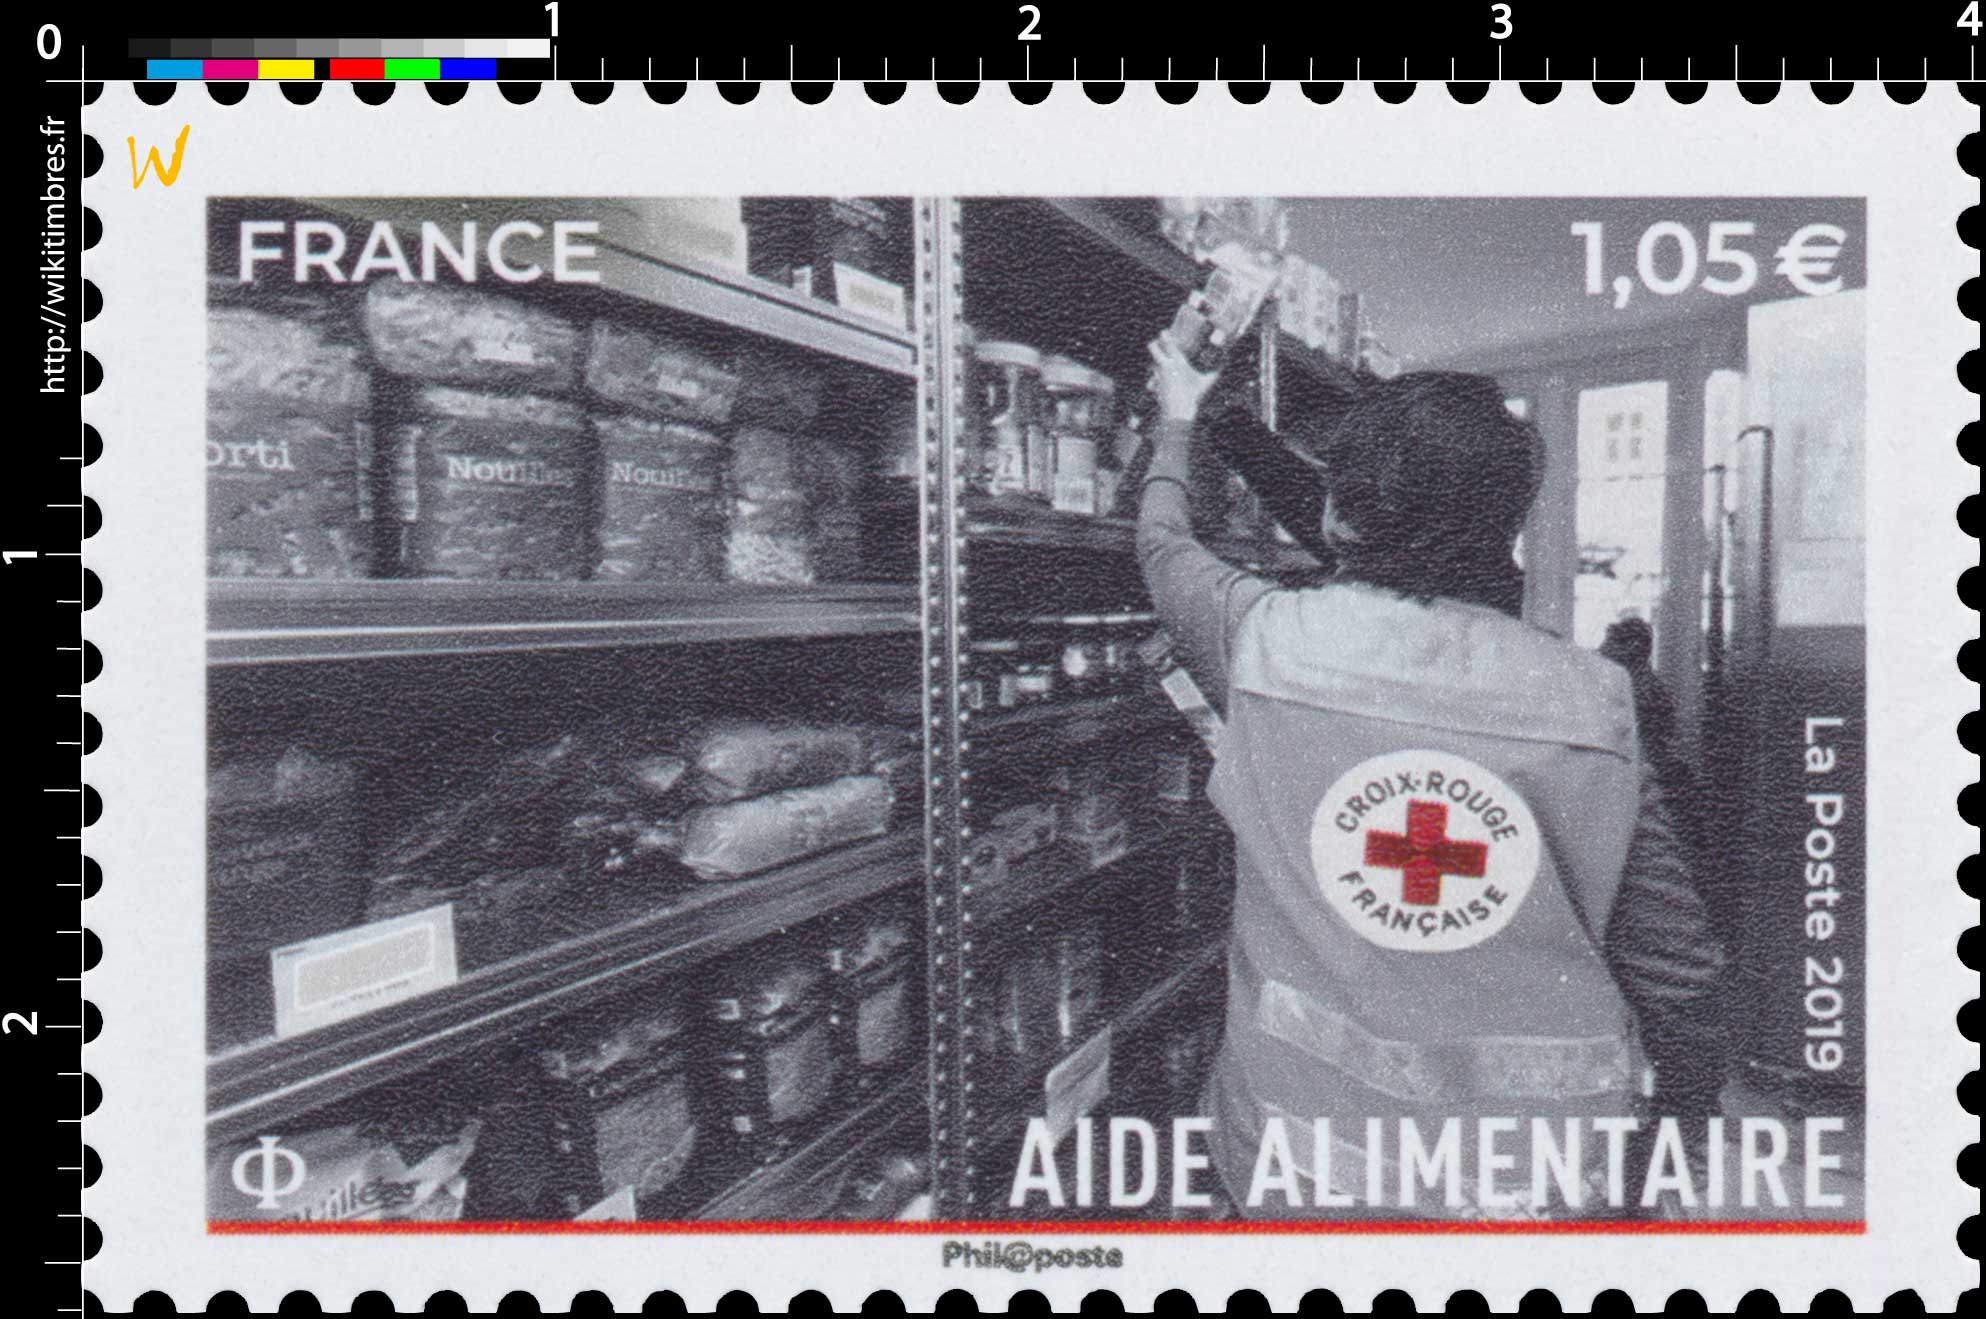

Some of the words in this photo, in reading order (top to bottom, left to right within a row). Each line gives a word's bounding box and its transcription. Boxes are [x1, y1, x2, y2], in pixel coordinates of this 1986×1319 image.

[239, 220, 602, 284] FRANCE
[1804, 716, 1844, 774] La
[1804, 793, 1844, 941] Poste
[1337, 870, 1509, 937] FRANÇAISE
[1804, 956, 1844, 1073] 2019
[1009, 1116, 1214, 1208] AIDE
[1245, 1116, 1846, 1208] ALIMENTAIRE
[942, 1240, 1124, 1274] Phil@poste
